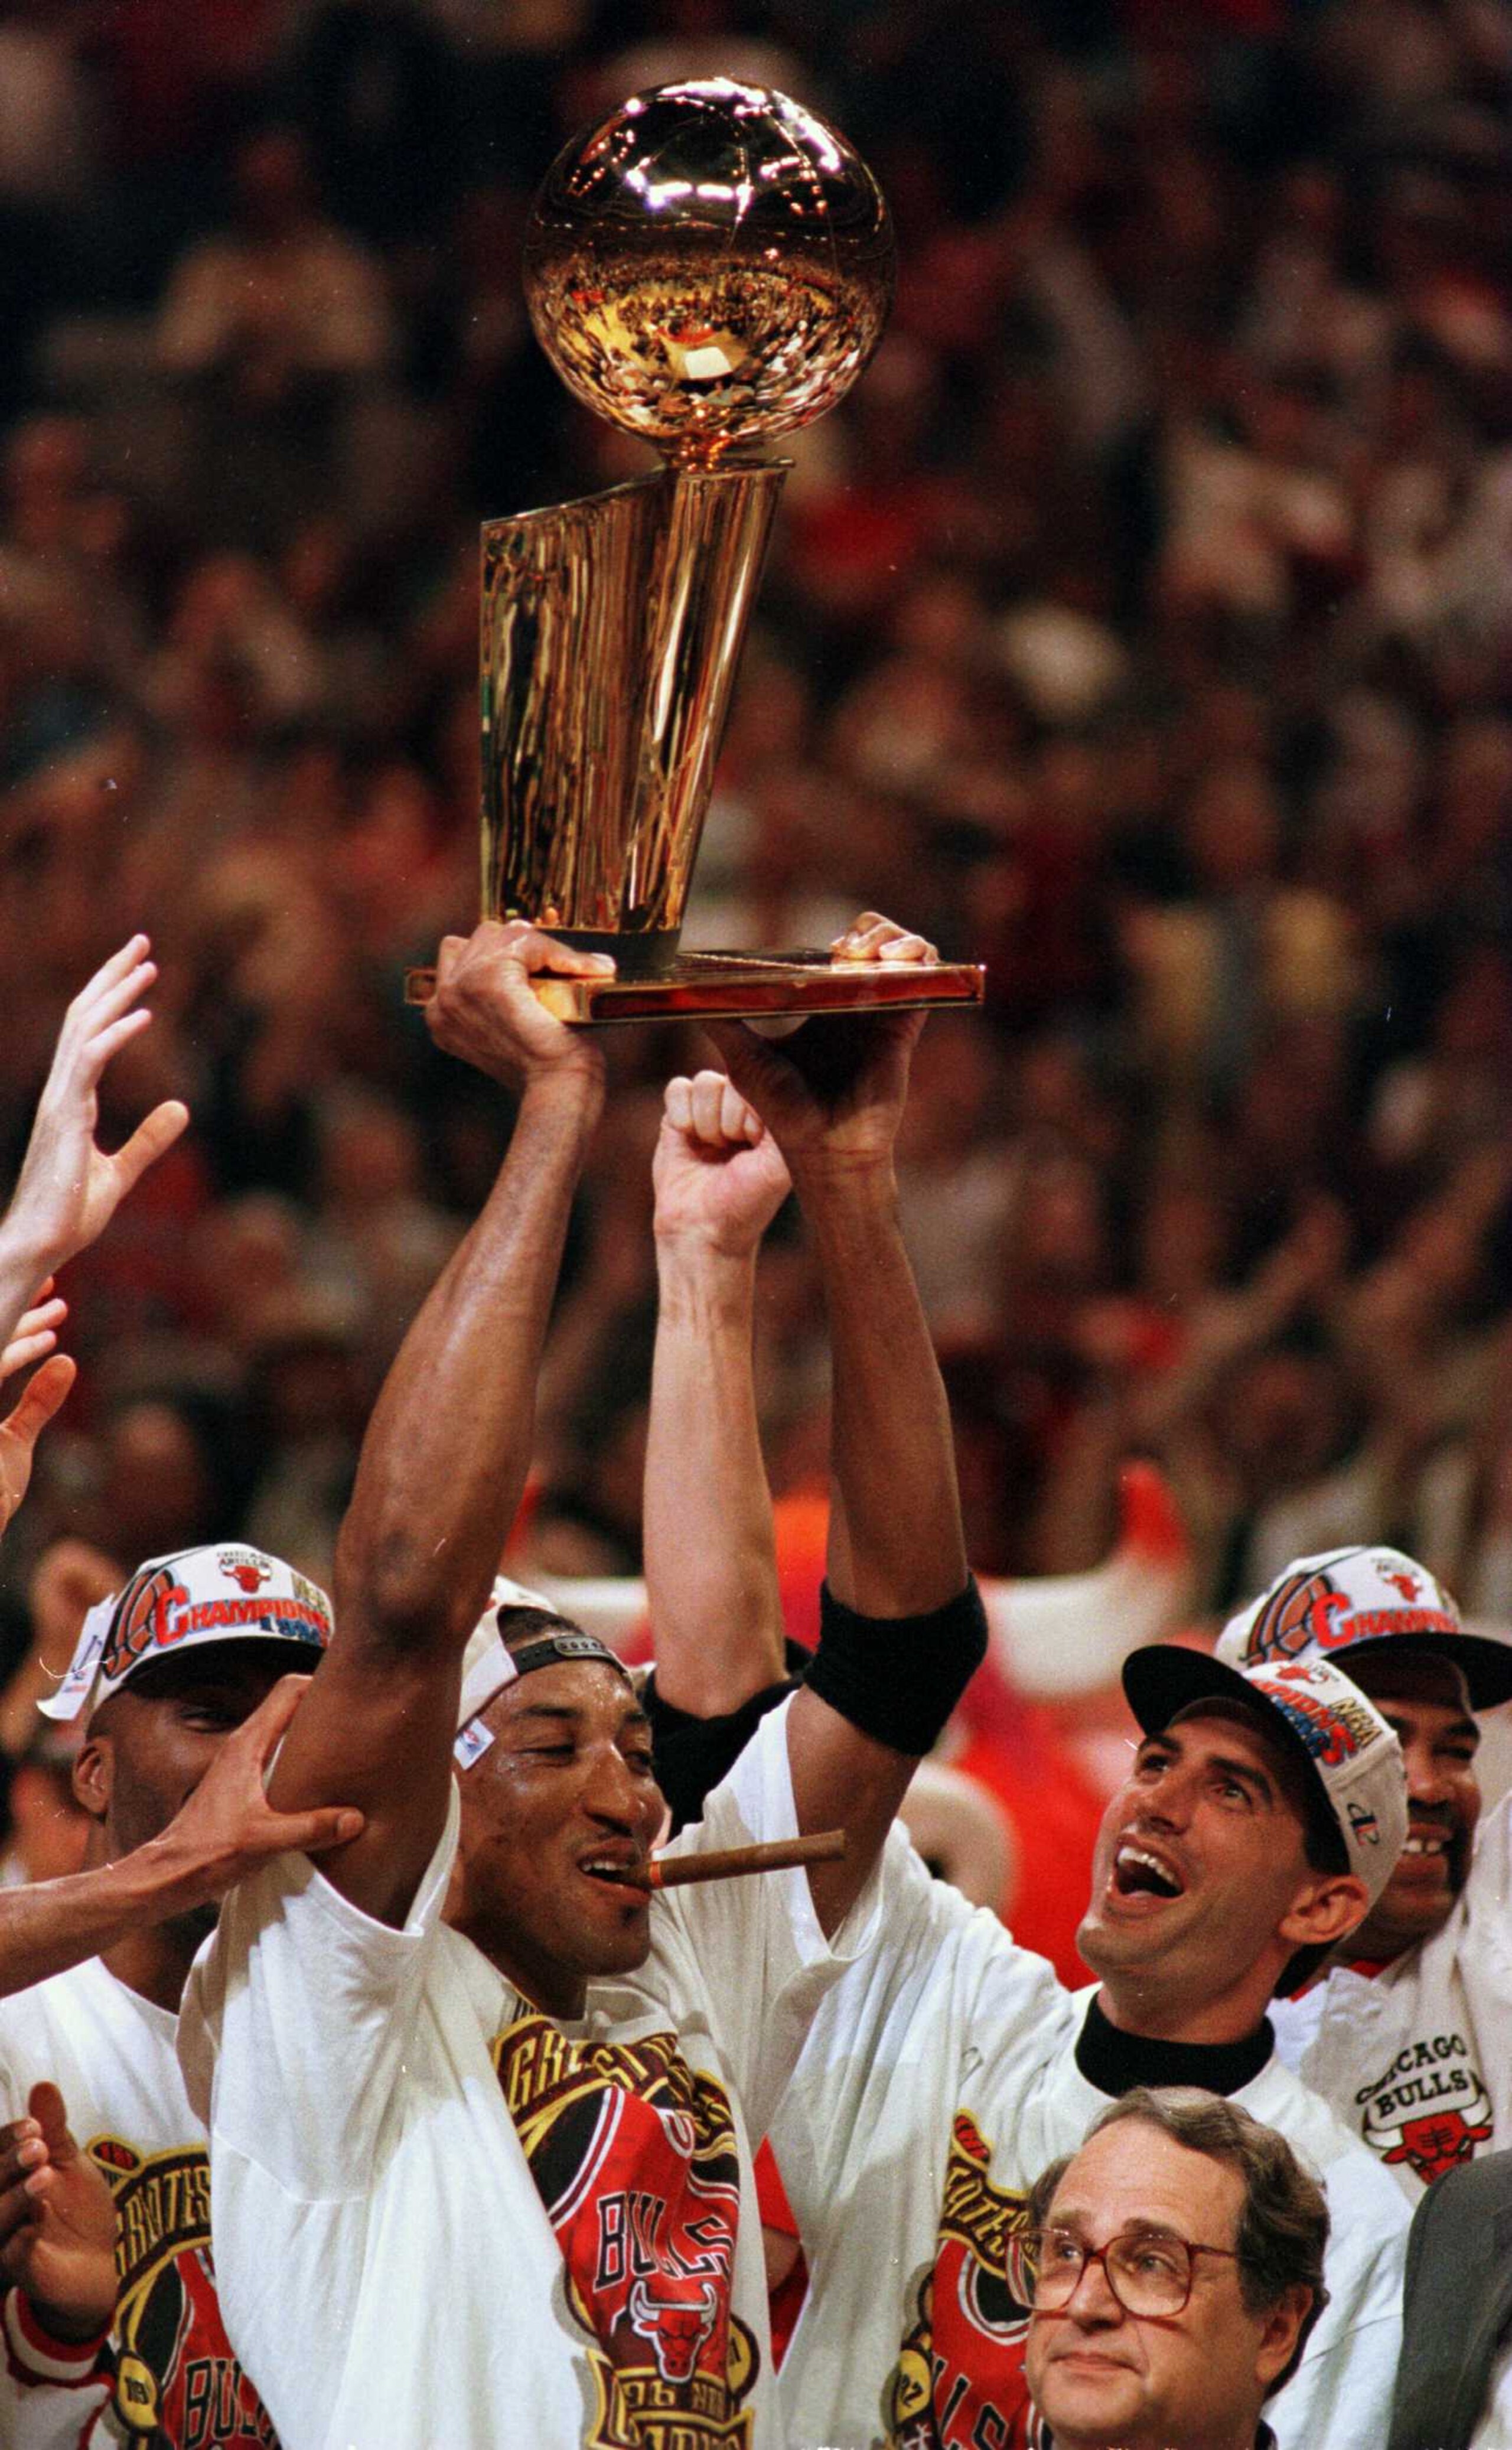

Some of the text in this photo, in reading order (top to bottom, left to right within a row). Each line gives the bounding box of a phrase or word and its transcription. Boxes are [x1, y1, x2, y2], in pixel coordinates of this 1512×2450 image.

[1330, 1696, 1384, 1747] NBA
[1355, 2034, 1467, 2105] CHICAGO
[1375, 2069, 1468, 2118] BULLS
[592, 2191, 734, 2294] BULLS
